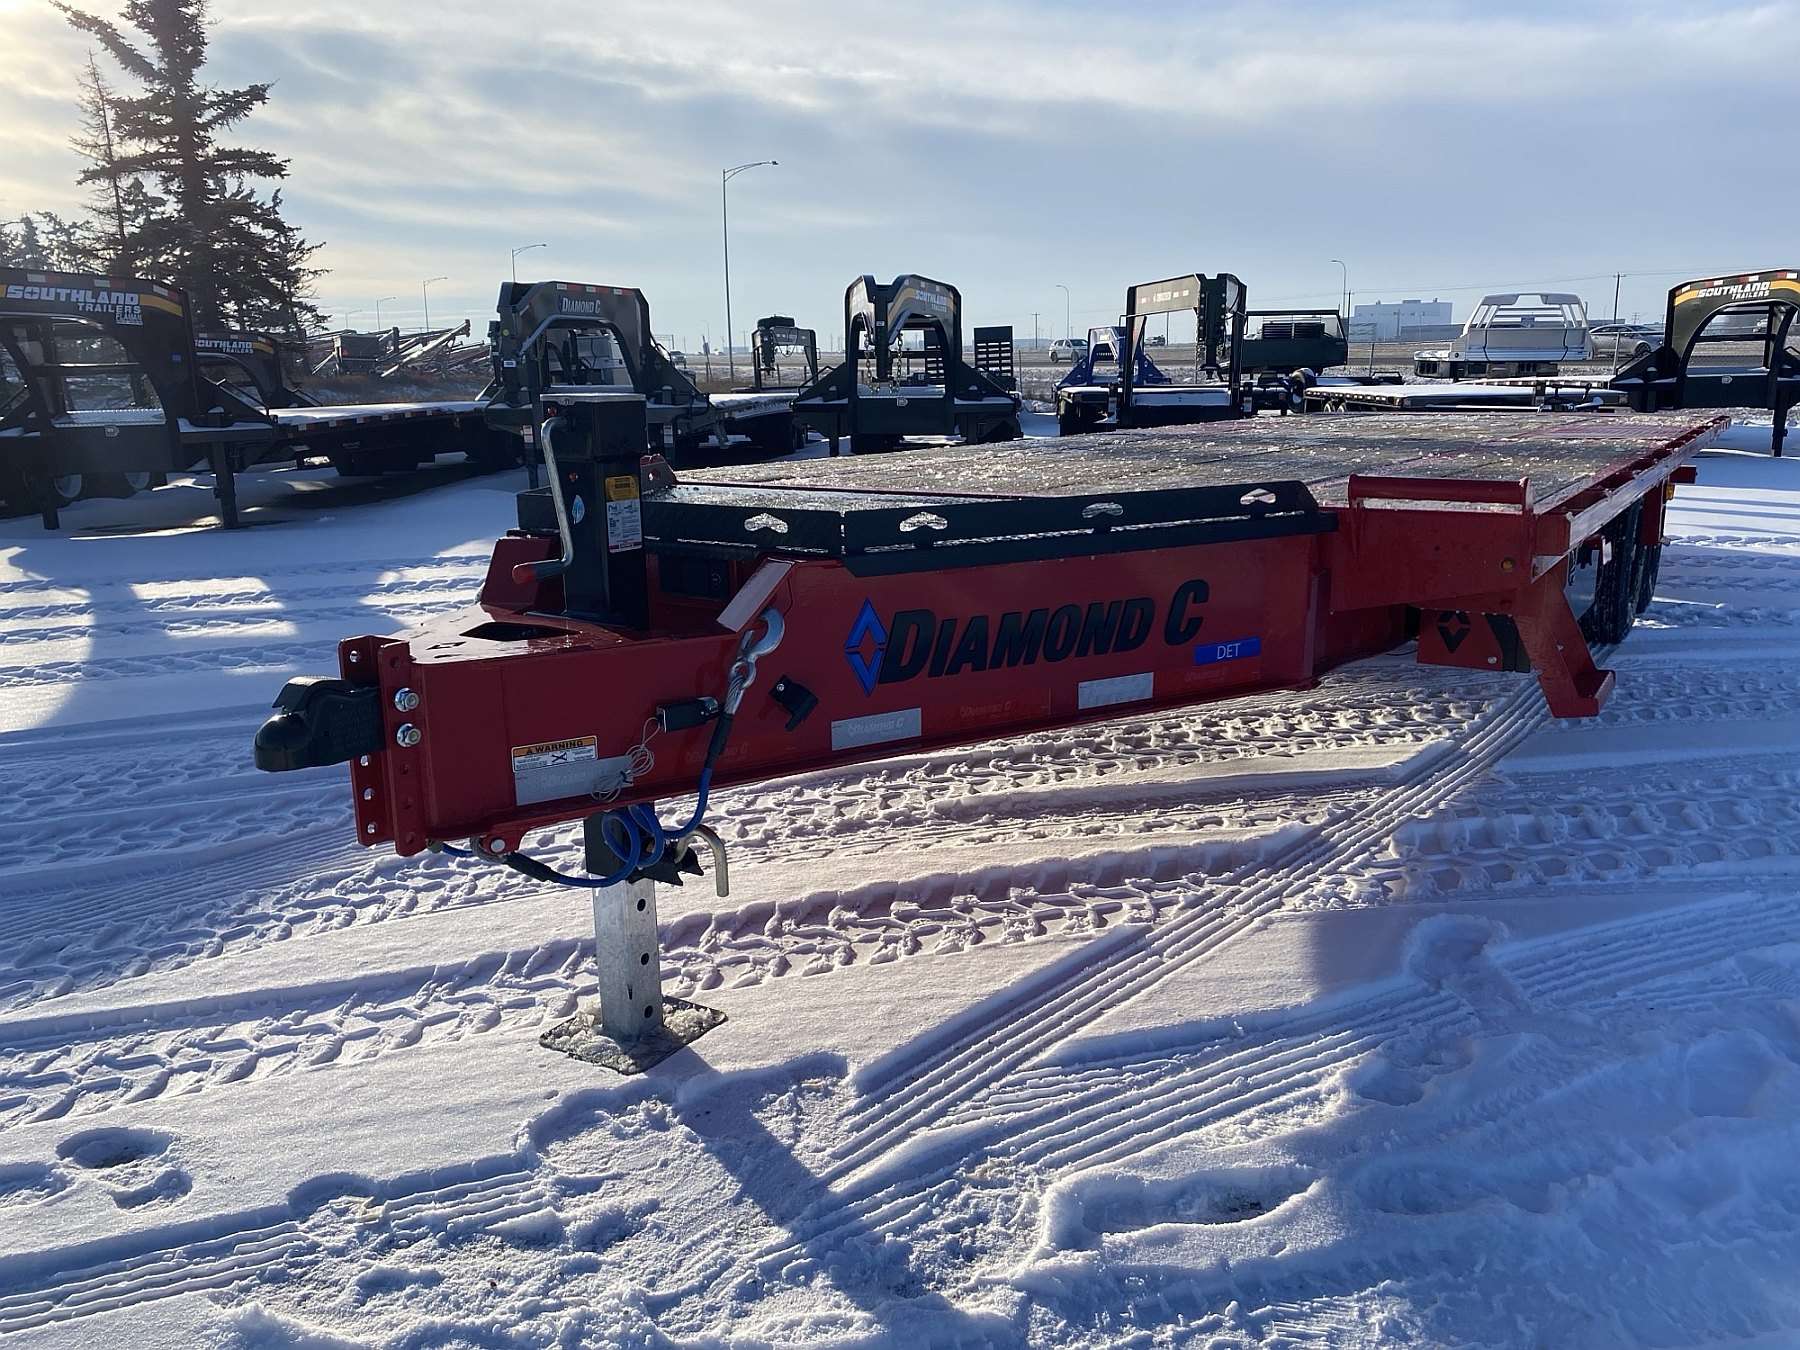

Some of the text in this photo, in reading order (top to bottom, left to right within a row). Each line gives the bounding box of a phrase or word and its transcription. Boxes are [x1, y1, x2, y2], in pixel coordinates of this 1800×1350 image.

[6, 285, 139, 305] SOUTHLAND
[1697, 281, 1771, 298] SOUTHLAND
[1730, 290, 1770, 300] TRAILERS
[78, 302, 142, 314] TRAILERS
[877, 578, 1210, 685] DIAMOND C
[1216, 642, 1241, 660] DET
[535, 739, 584, 754] WARNING
